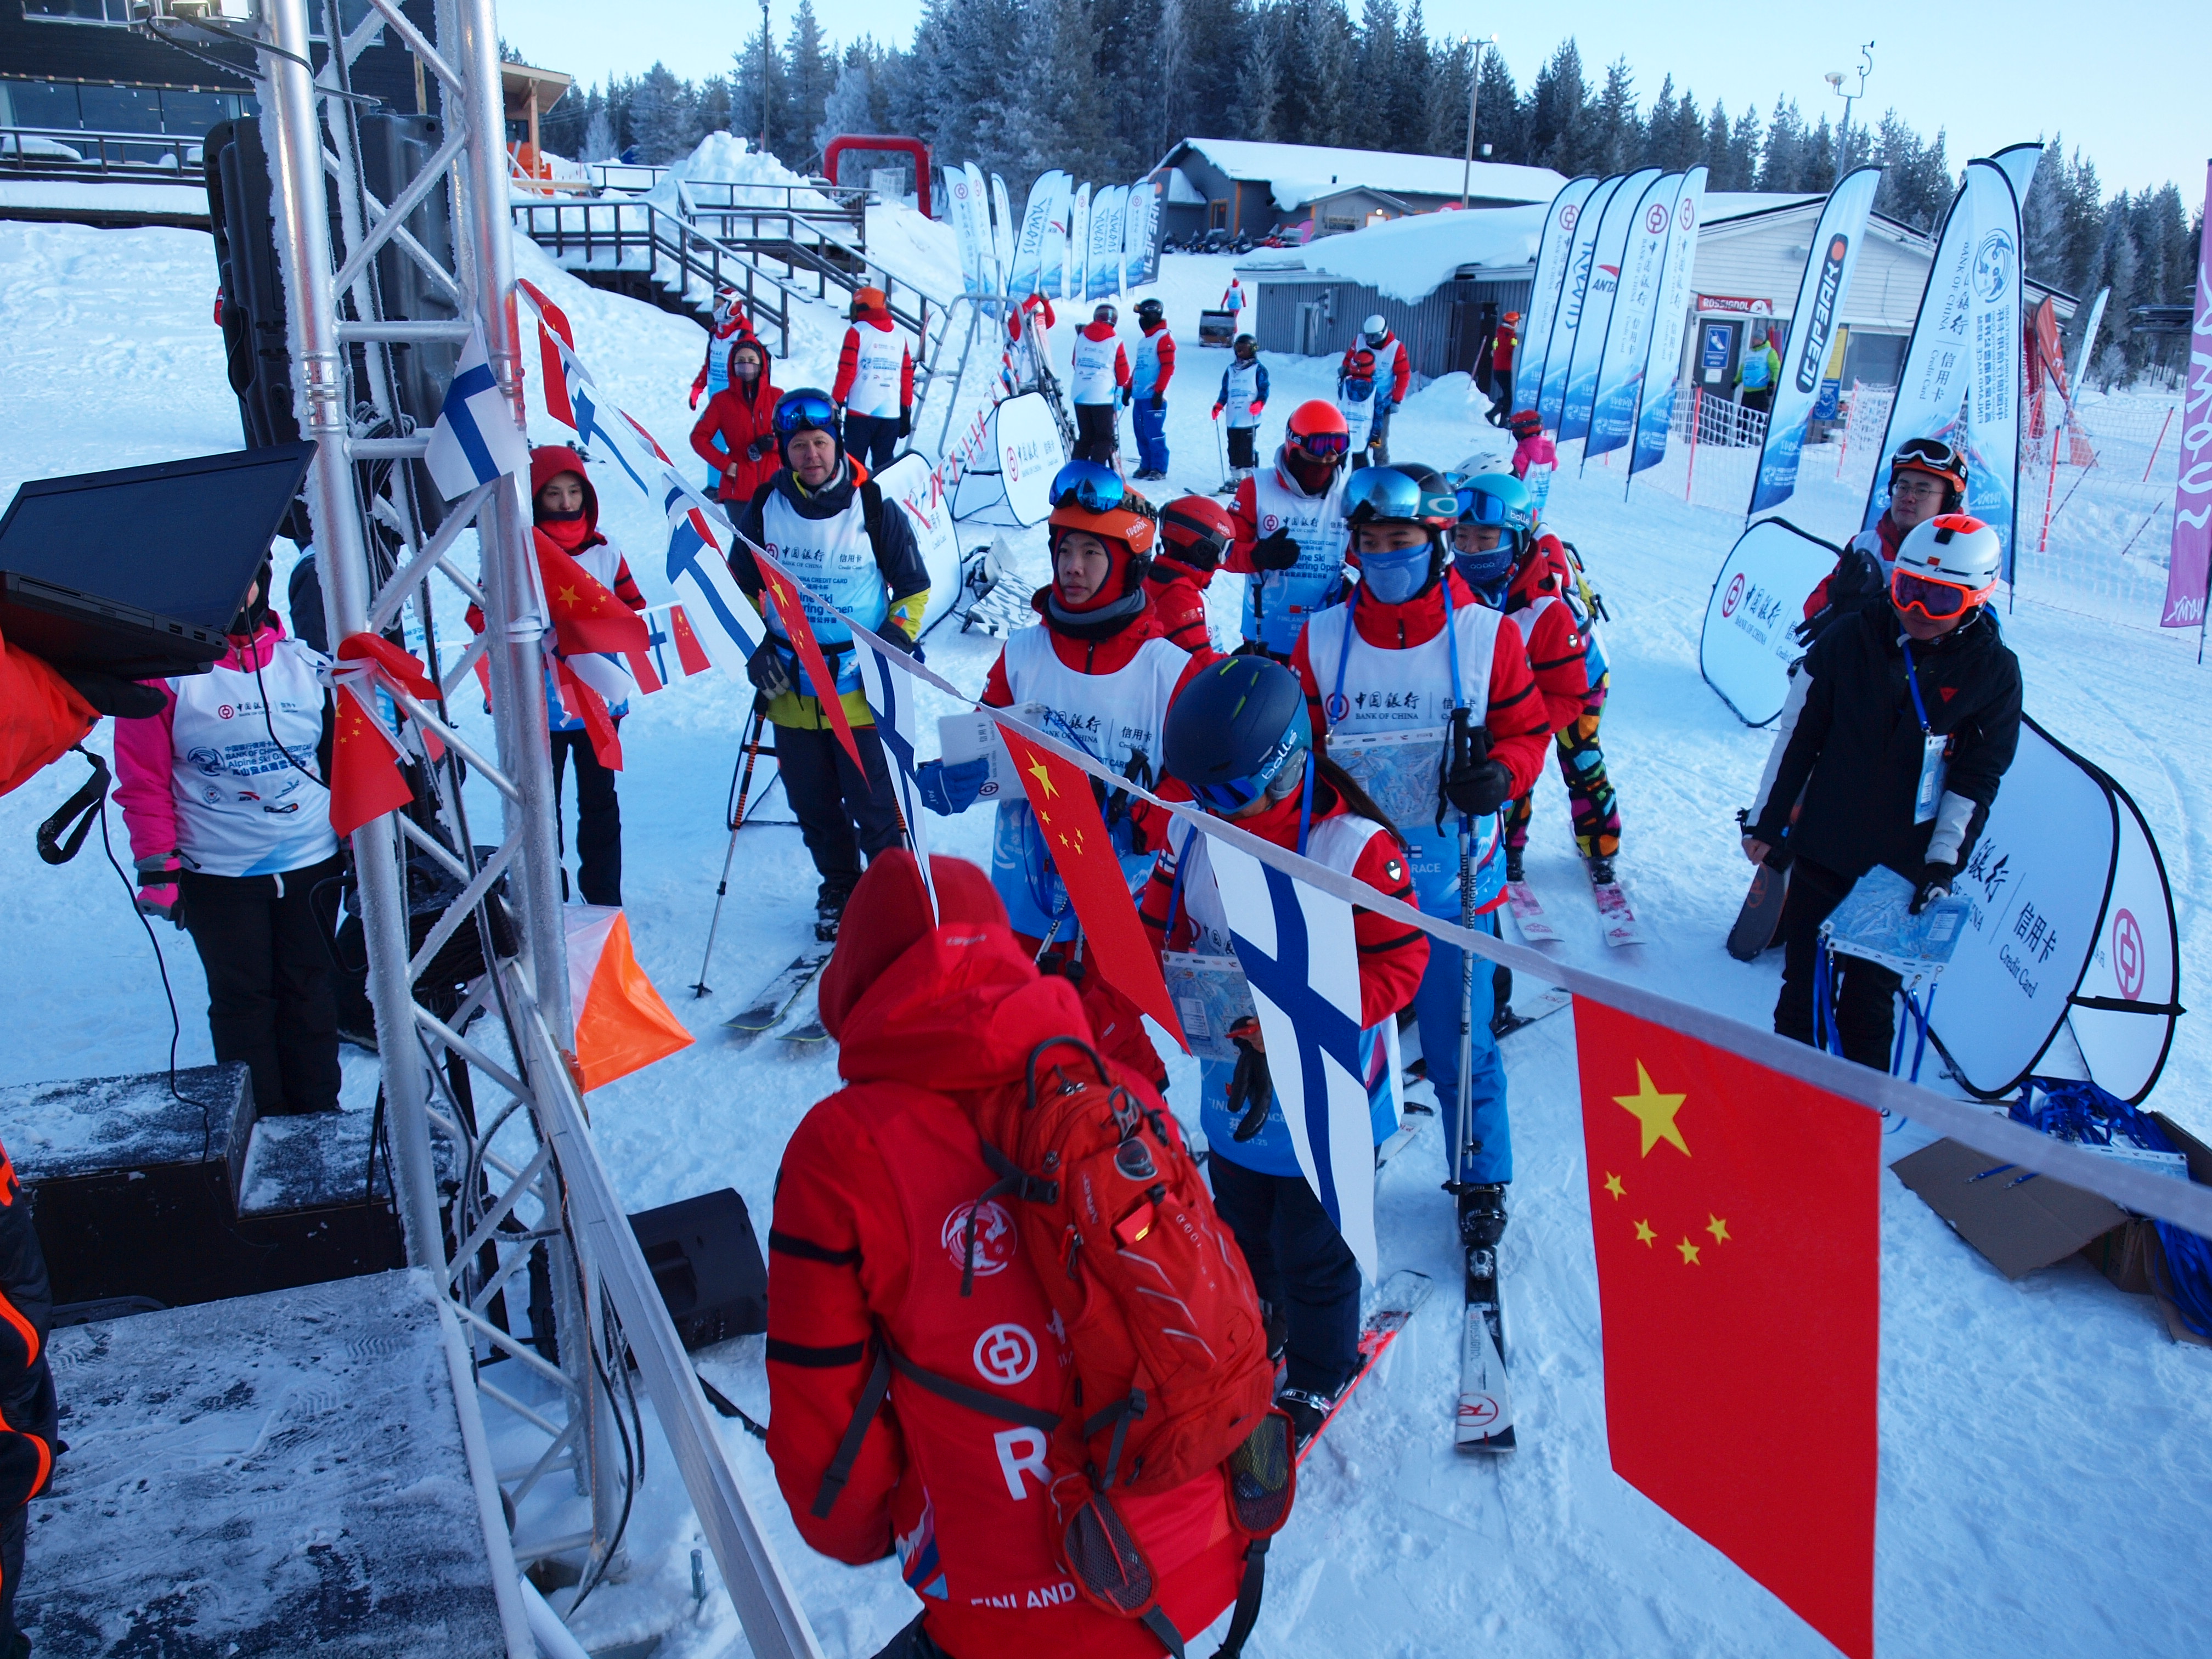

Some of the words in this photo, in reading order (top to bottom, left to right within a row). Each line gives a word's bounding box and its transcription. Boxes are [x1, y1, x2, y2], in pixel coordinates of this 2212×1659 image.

[1951, 276, 1961, 290] OF
[1703, 297, 1750, 310] ROSSIGNOL
[1939, 294, 1955, 331] CHINA
[1931, 352, 1956, 403] 信用卡
[782, 545, 825, 562] 中国银行
[839, 553, 862, 563] 信用卡
[1743, 583, 1781, 629] 中国银行
[1752, 628, 1767, 646] CHINA
[1355, 691, 1420, 709] 中国银行
[1443, 697, 1476, 710] 信卡
[1044, 710, 1102, 733] 中国银行
[1121, 726, 1153, 742] 信用卡
[225, 751, 247, 760] BANK
[228, 758, 257, 769] Alpine
[258, 755, 271, 764] Ski
[1261, 729, 1297, 780] bollé
[1411, 863, 1441, 873] RACE
[1468, 874, 1477, 929] ROSSIGNOL
[1968, 837, 2010, 904] 银行
[2013, 901, 2057, 964] 信用卡
[1999, 944, 2020, 979] Credit
[2018, 968, 2039, 999] Card
